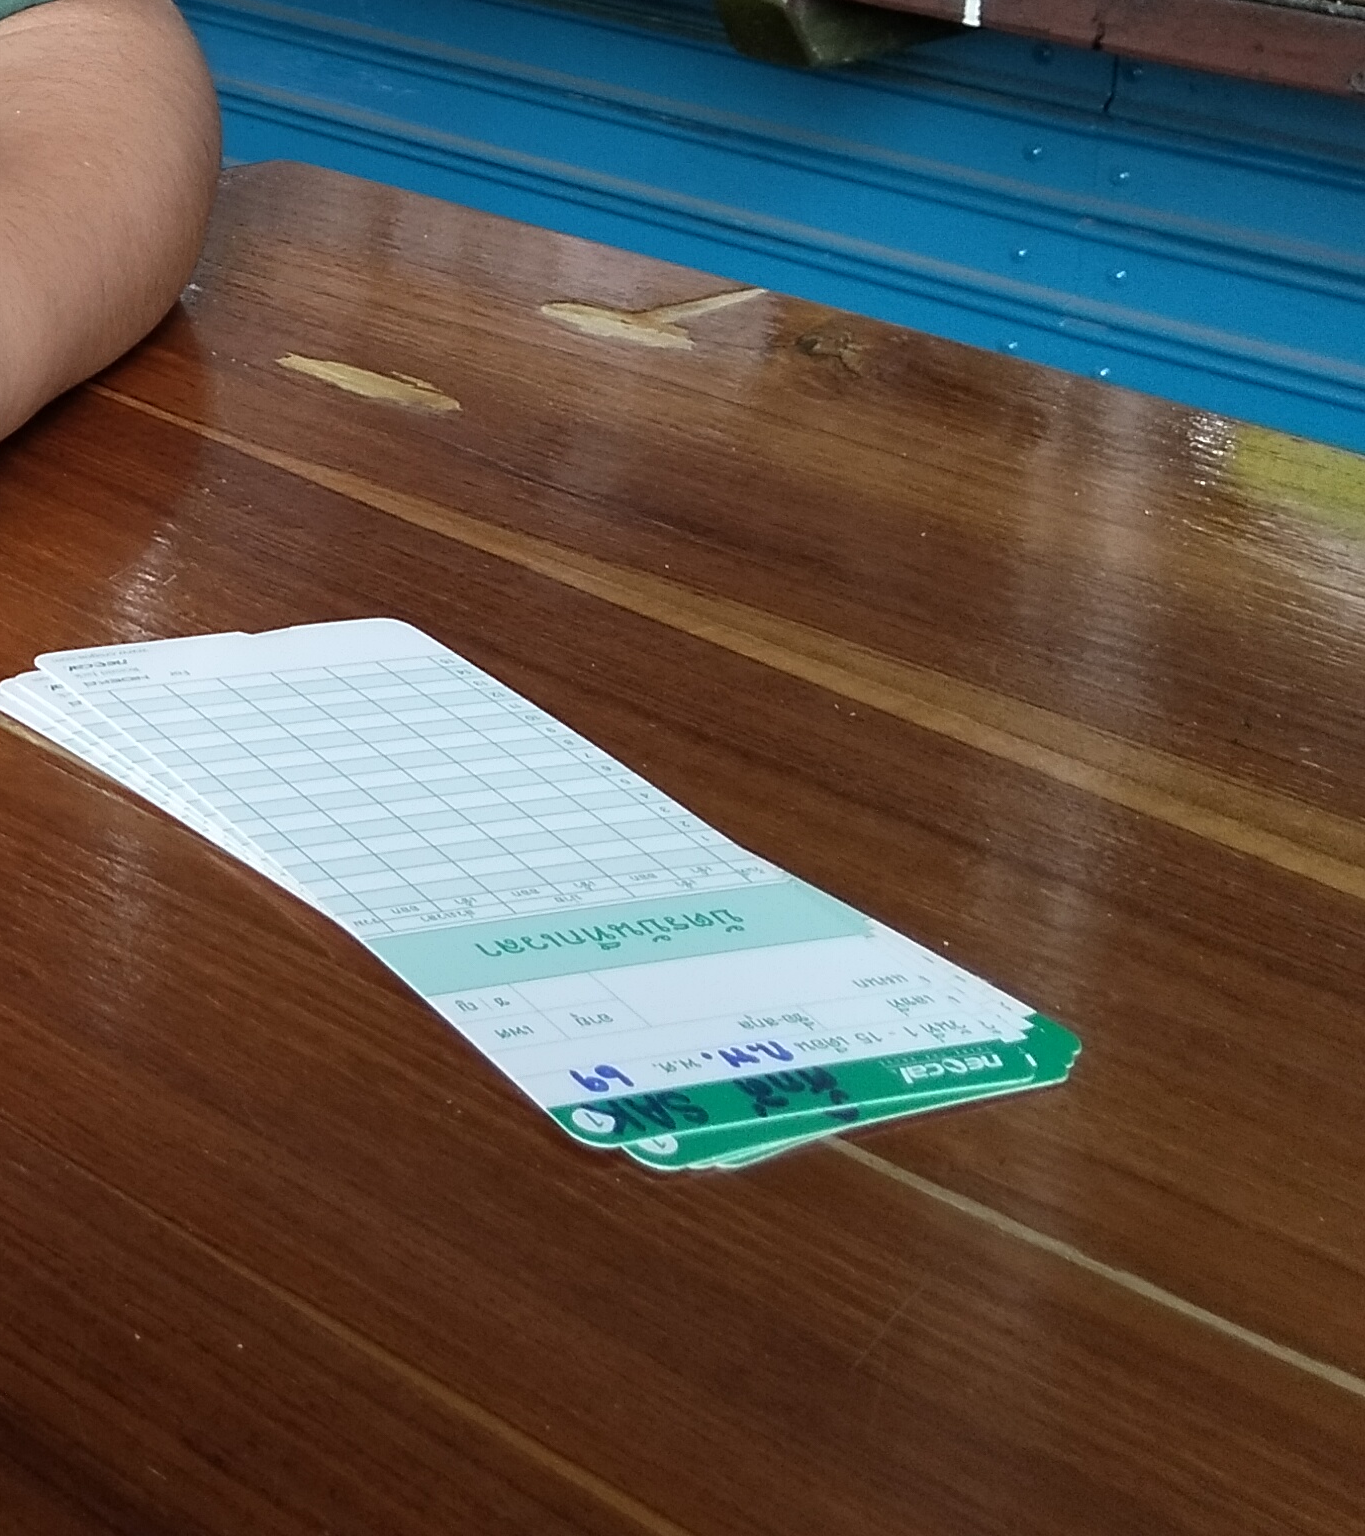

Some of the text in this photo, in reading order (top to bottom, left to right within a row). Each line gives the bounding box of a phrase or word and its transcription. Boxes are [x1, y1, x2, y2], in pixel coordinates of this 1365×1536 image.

[474, 909, 745, 958] บัตรบันทึกเวลา
[852, 973, 909, 990] แผนก
[569, 1012, 614, 1026] อายุ
[494, 1024, 534, 1039] เพศ
[652, 1020, 966, 1074] วันที่ 1 15 เดือน พ.ศ.
[899, 1053, 1004, 1085] neocal
[585, 1113, 605, 1128] 1
